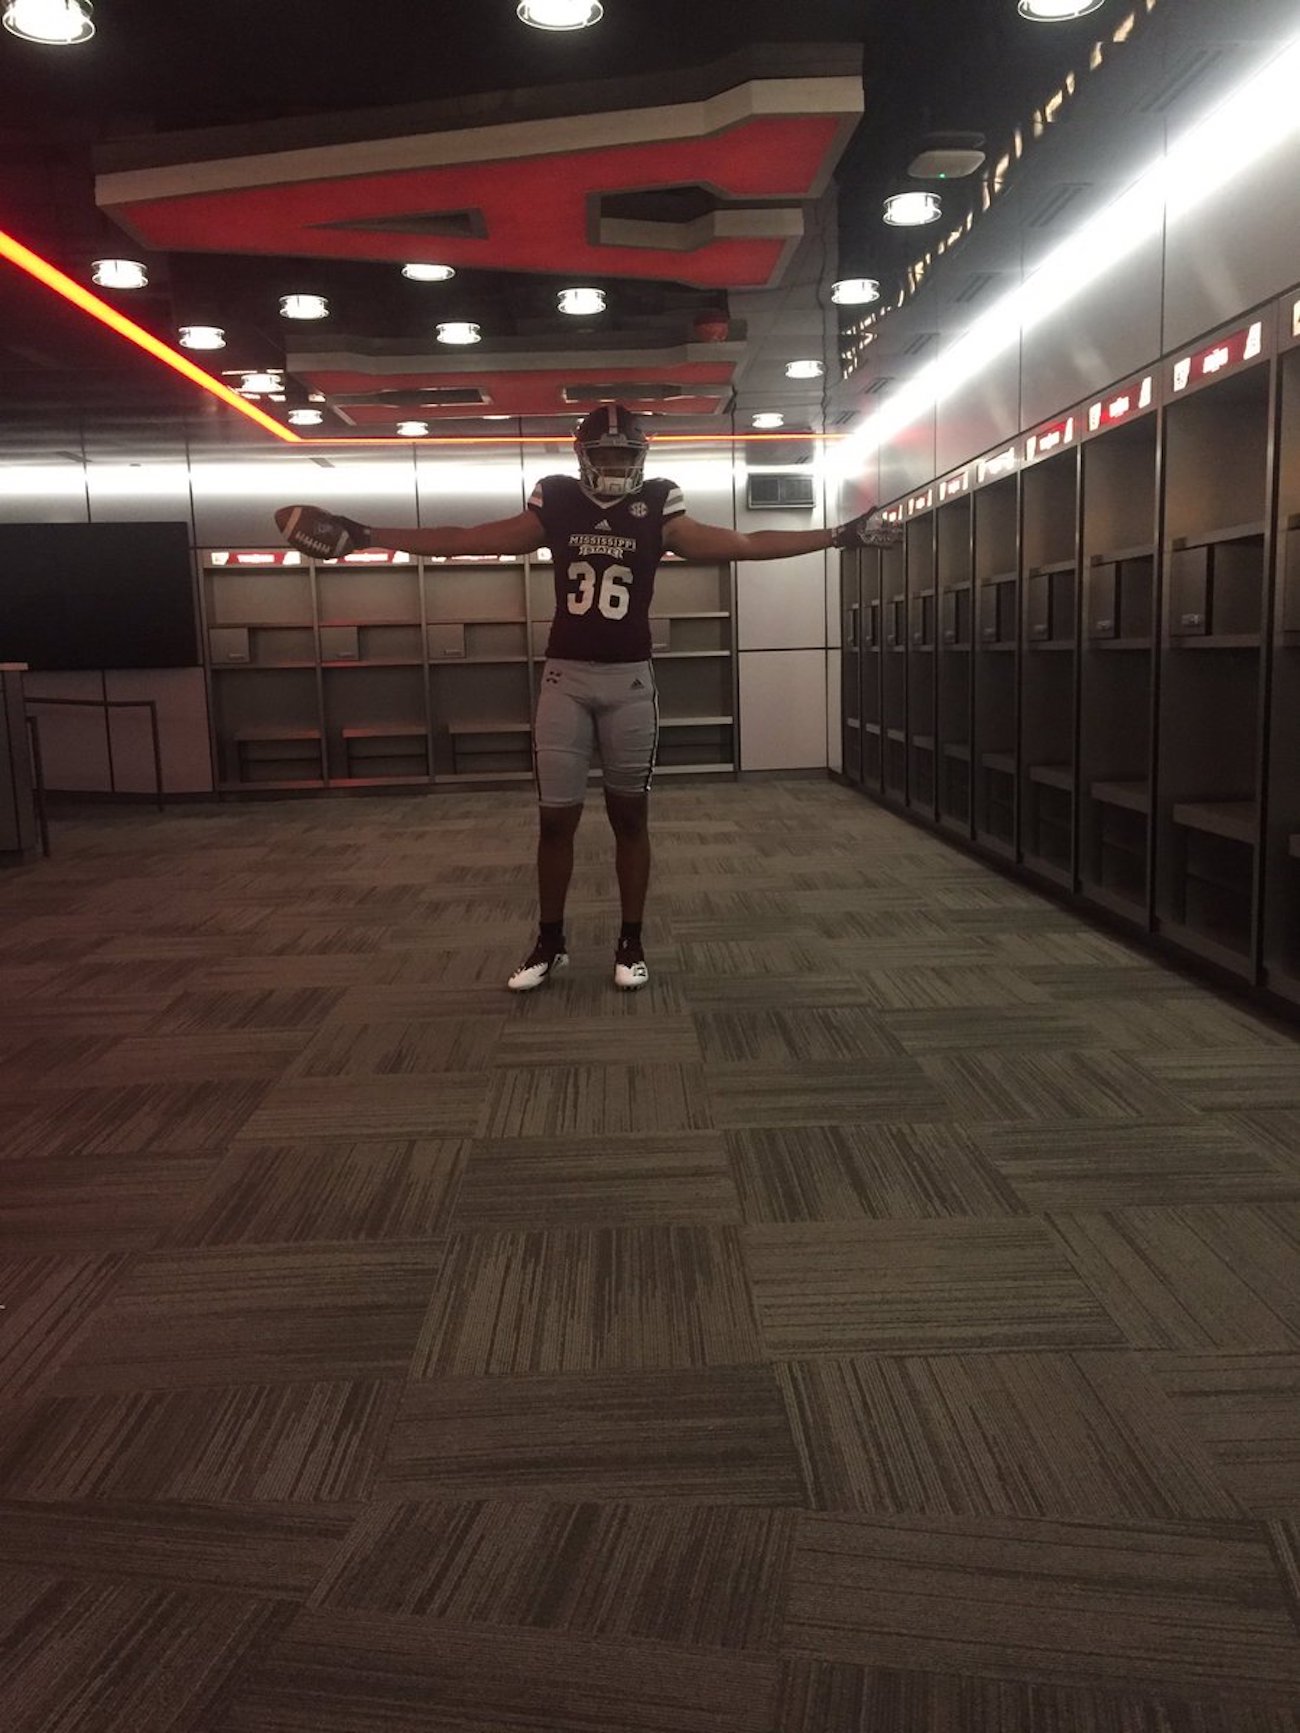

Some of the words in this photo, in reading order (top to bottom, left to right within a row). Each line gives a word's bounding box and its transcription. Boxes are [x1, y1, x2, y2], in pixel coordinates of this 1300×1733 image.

[568, 534, 637, 552] MISSISSIPPI
[579, 545, 623, 559] STATE
[567, 561, 634, 620] 36
